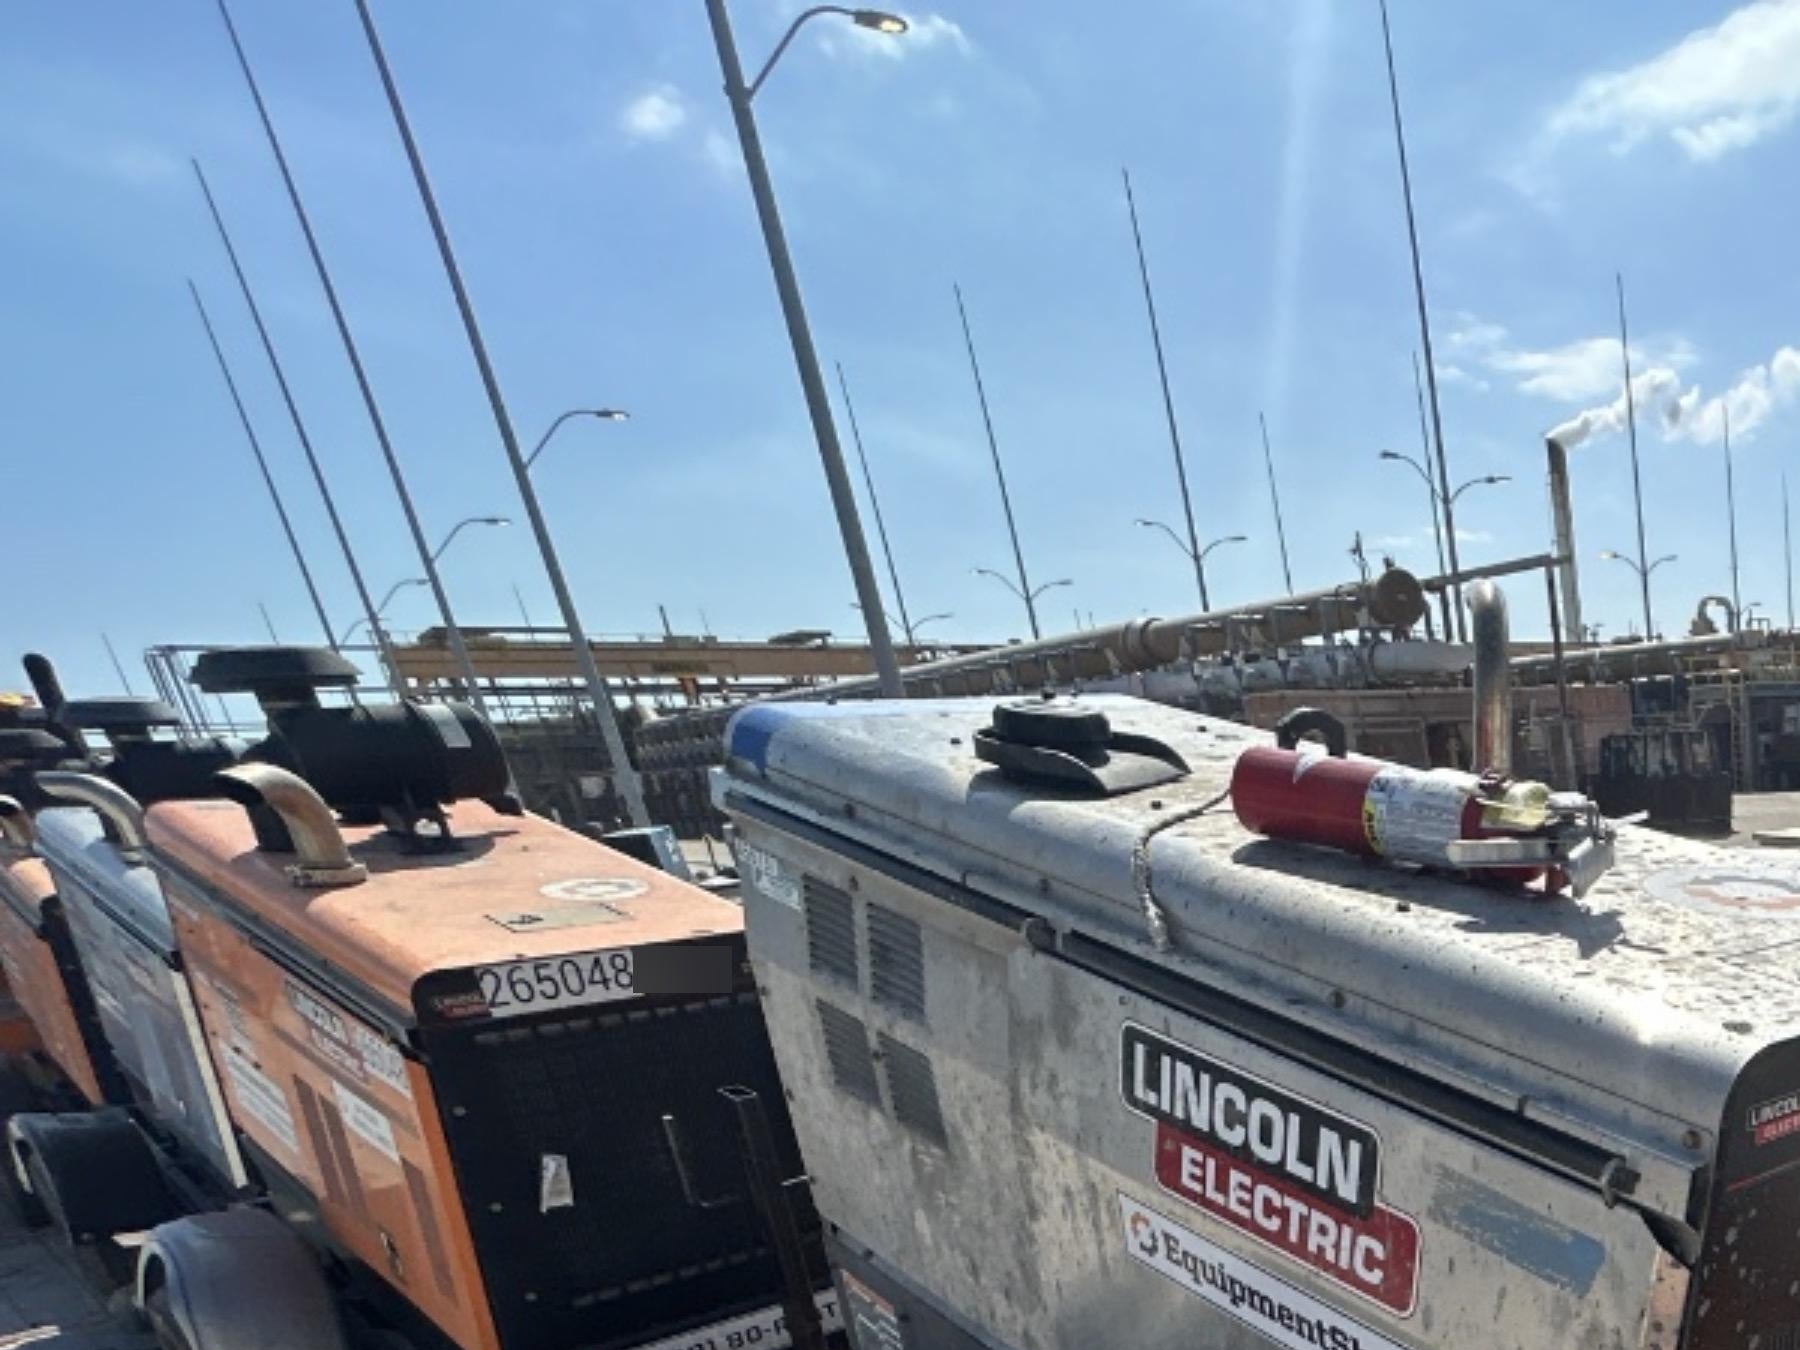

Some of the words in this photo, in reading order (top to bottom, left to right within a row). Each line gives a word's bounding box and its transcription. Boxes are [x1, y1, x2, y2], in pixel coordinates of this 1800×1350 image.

[479, 952, 634, 1007] 265048
[1133, 1042, 1362, 1204] LINCOLN
[1179, 1144, 1386, 1287] ELECTRIC
